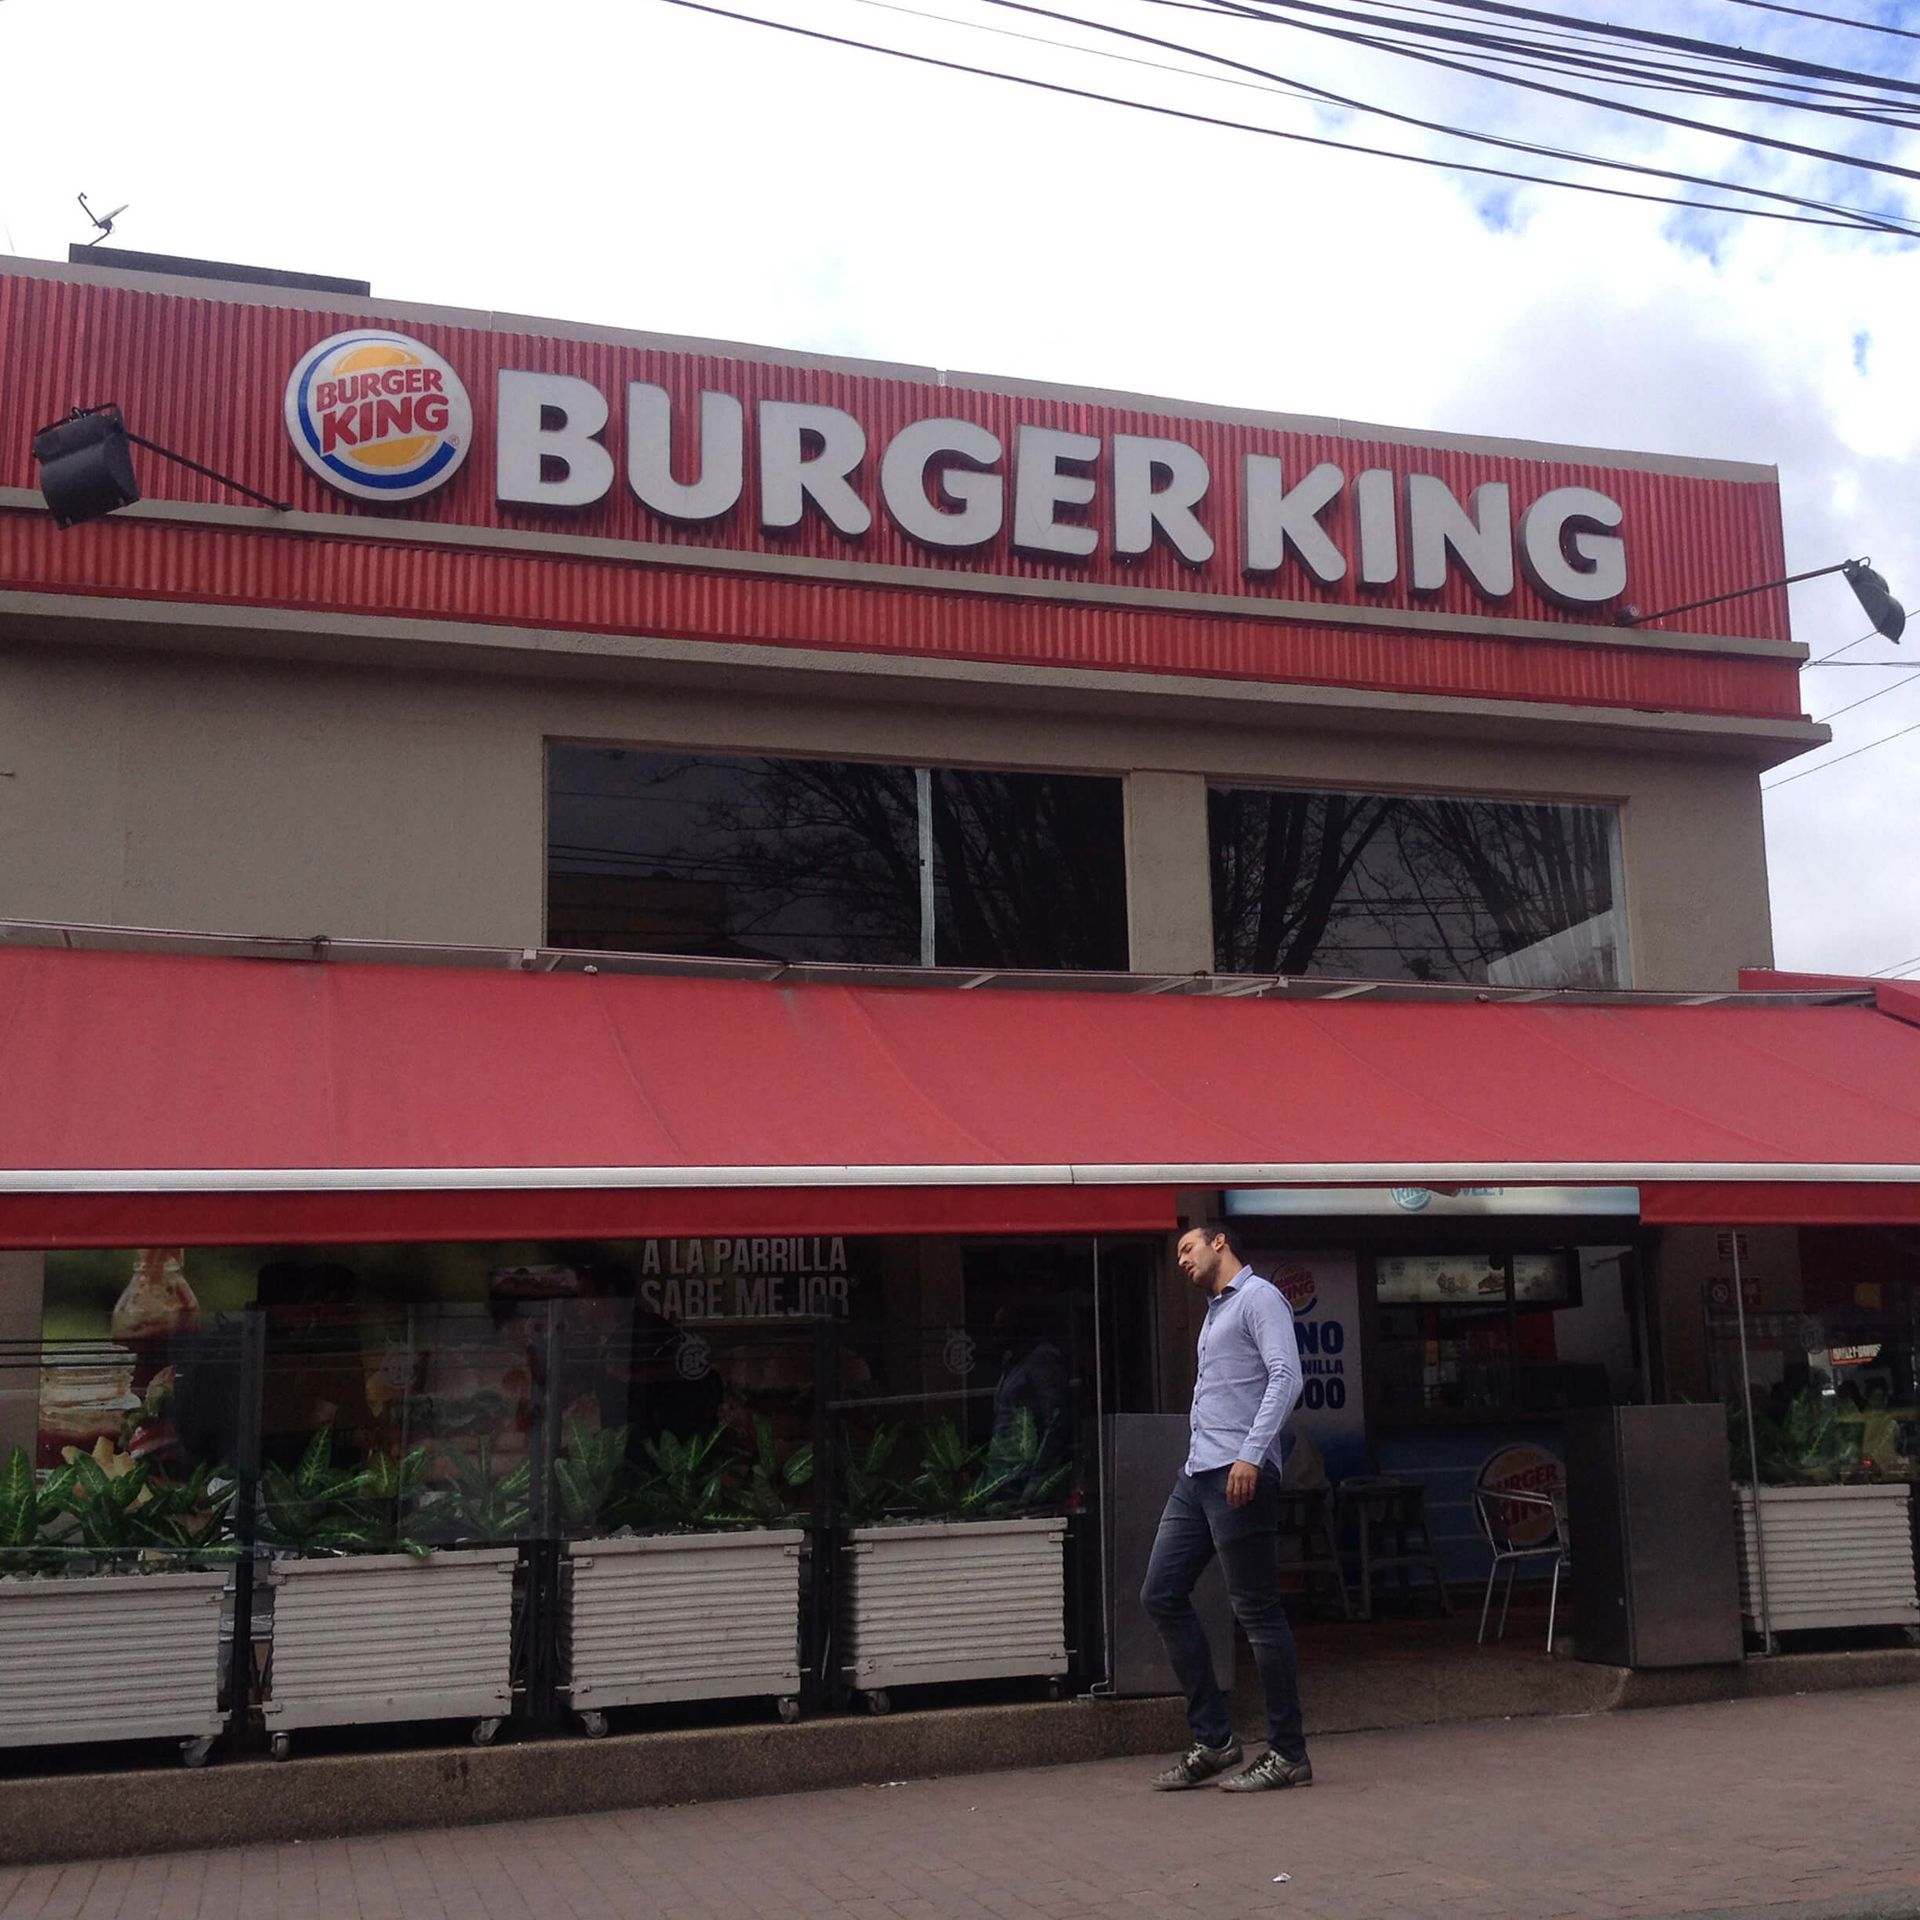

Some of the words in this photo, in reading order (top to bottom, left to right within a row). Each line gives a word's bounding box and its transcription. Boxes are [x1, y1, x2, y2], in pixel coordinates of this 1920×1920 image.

[316, 368, 443, 412] BURGER
[322, 394, 449, 453] KING
[496, 368, 1215, 563] BURGER
[1243, 453, 1628, 602] KING
[641, 1238, 661, 1275] A
[670, 1238, 705, 1275] LA
[714, 1236, 847, 1273] PARRILLA
[641, 1277, 724, 1320] SABE
[736, 1275, 849, 1317] MEJOR
[1294, 1321, 1344, 1354] NO
[1302, 1359, 1344, 1375] NILLA
[1294, 1378, 1345, 1410] 00
